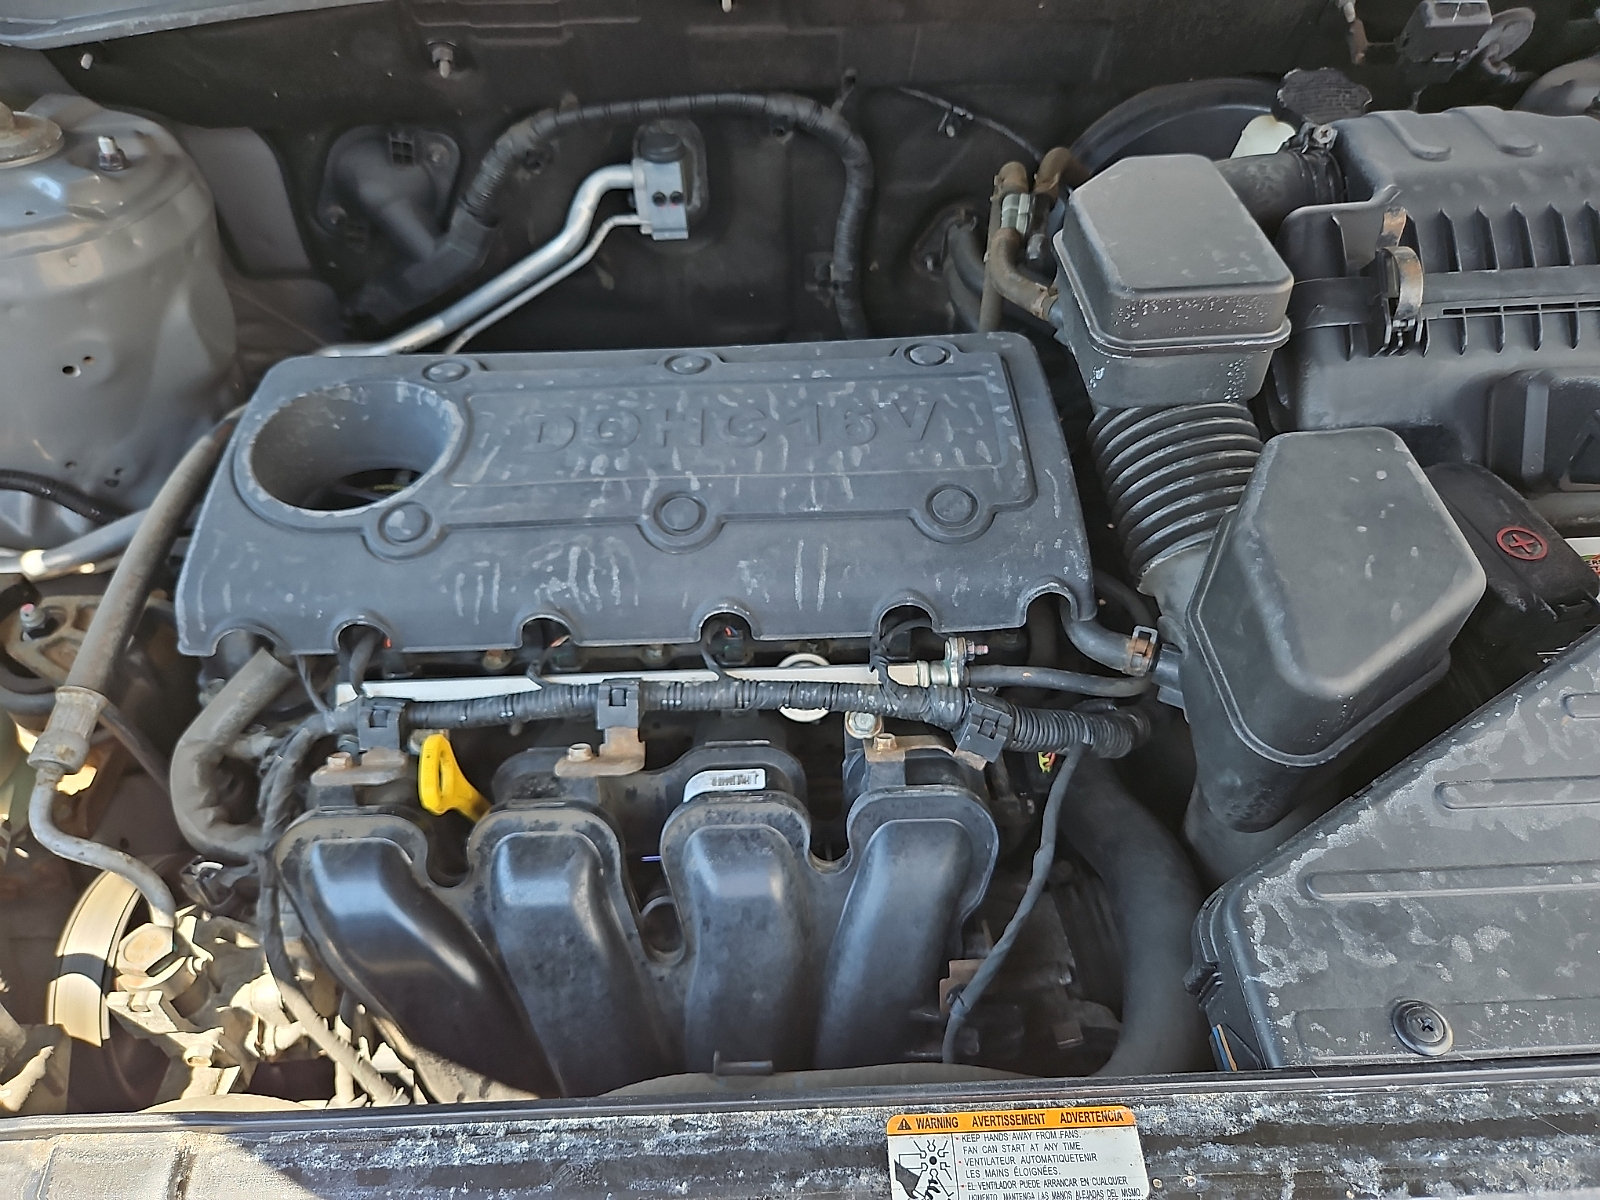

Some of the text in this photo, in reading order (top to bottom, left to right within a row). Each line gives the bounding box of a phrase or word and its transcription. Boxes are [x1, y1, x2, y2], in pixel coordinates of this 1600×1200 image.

[916, 1110, 1124, 1130] WARNING AVERTISSEMENT ADVERTENCIA
[961, 1133, 981, 1143] KEEP
[984, 1132, 1009, 1142] HANDS
[1011, 1131, 1033, 1141] AWAY
[1036, 1130, 1057, 1140] FROM
[963, 1145, 978, 1155] FAN
[982, 1144, 998, 1154] CAN
[1002, 1143, 1026, 1153] START
[1030, 1143, 1040, 1152] AT
[1044, 1142, 1058, 1152] ANY
[964, 1153, 1098, 1166] VENTILATEUR AUTOMATIQUETENIR
[965, 1165, 1061, 1179] LES MAINS ÉLOIGNÉES.
[967, 1176, 1129, 1191] EL VENTILADOR PUEDE ARRANCAR EN CUALQUIER
[1003, 1192, 1035, 1200] MANTENGA
[1038, 1191, 1049, 1200] LAS
[1052, 1190, 1073, 1200] MANOS
[1106, 1188, 1119, 1198] DEL
